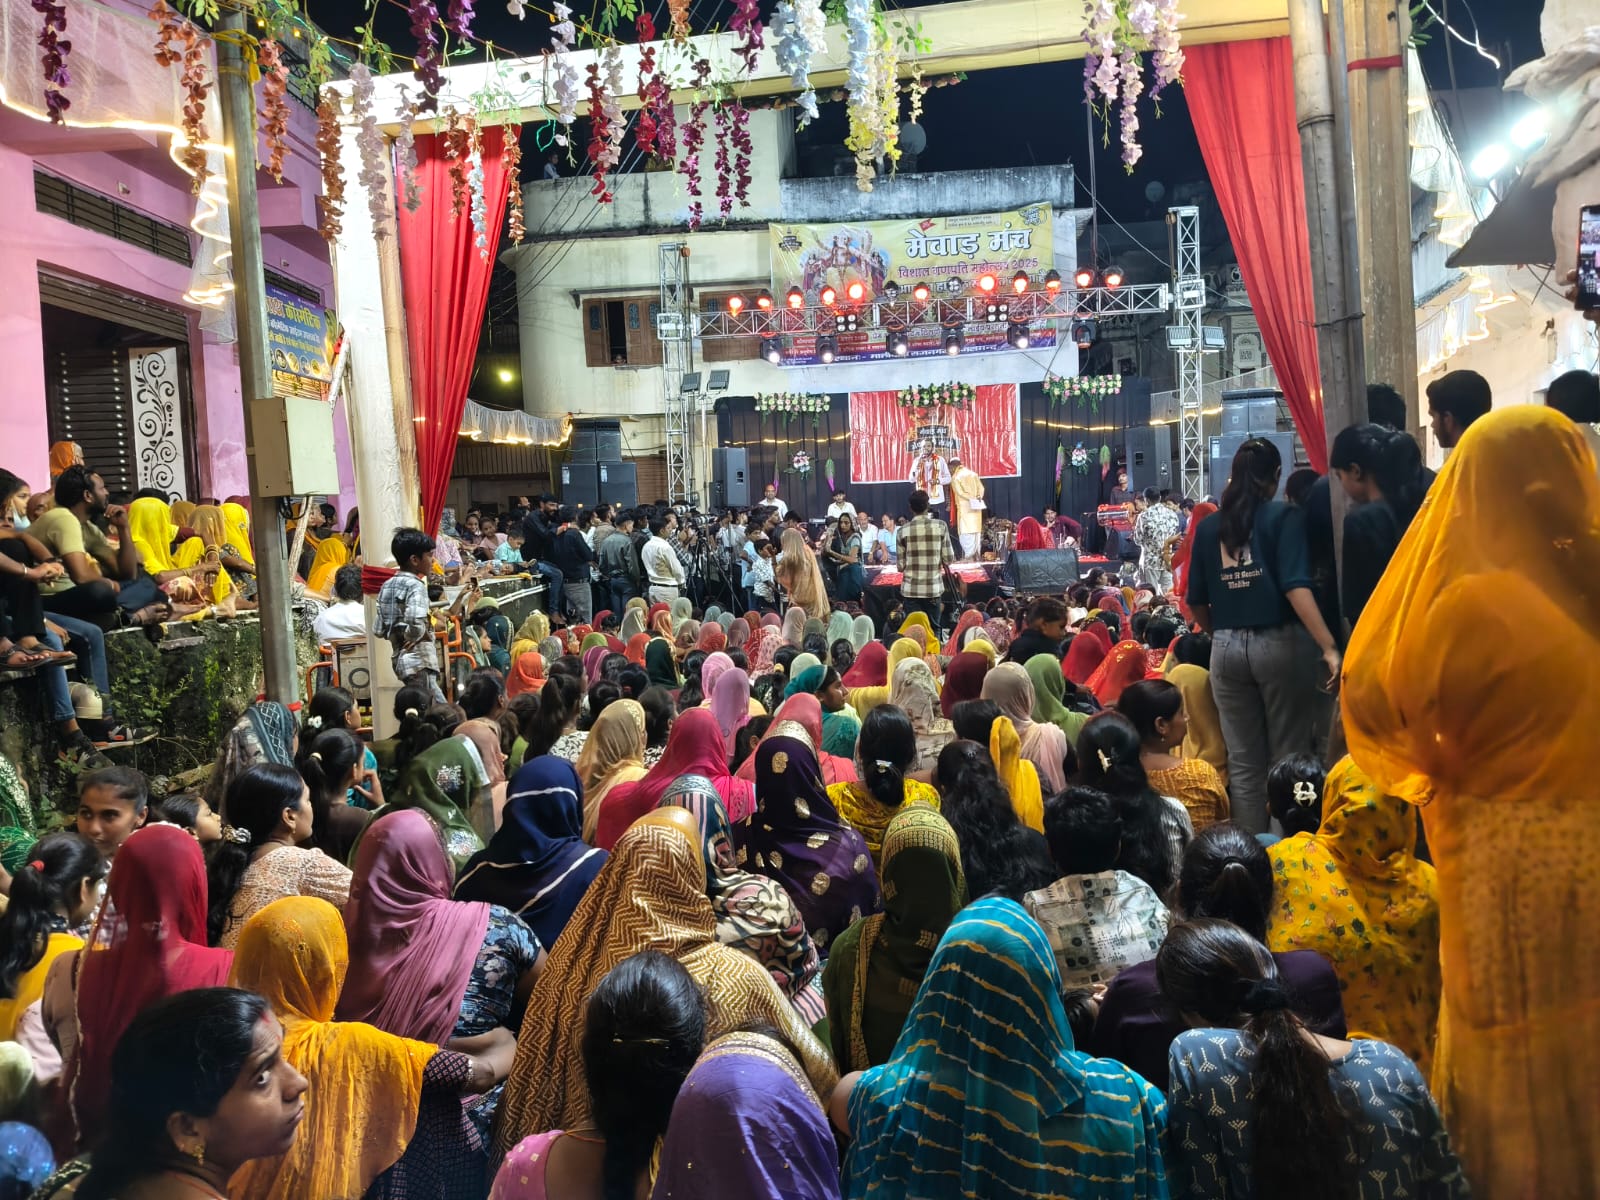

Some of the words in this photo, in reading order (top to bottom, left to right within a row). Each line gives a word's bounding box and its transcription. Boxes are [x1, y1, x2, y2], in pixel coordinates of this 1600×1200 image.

[904, 229, 980, 259] मेवाड़
[987, 222, 1033, 251] मंच
[898, 266, 930, 278] विशाल
[931, 261, 969, 275] गणपति
[971, 259, 1009, 274] महोत्सव
[1011, 258, 1039, 270] 2025
